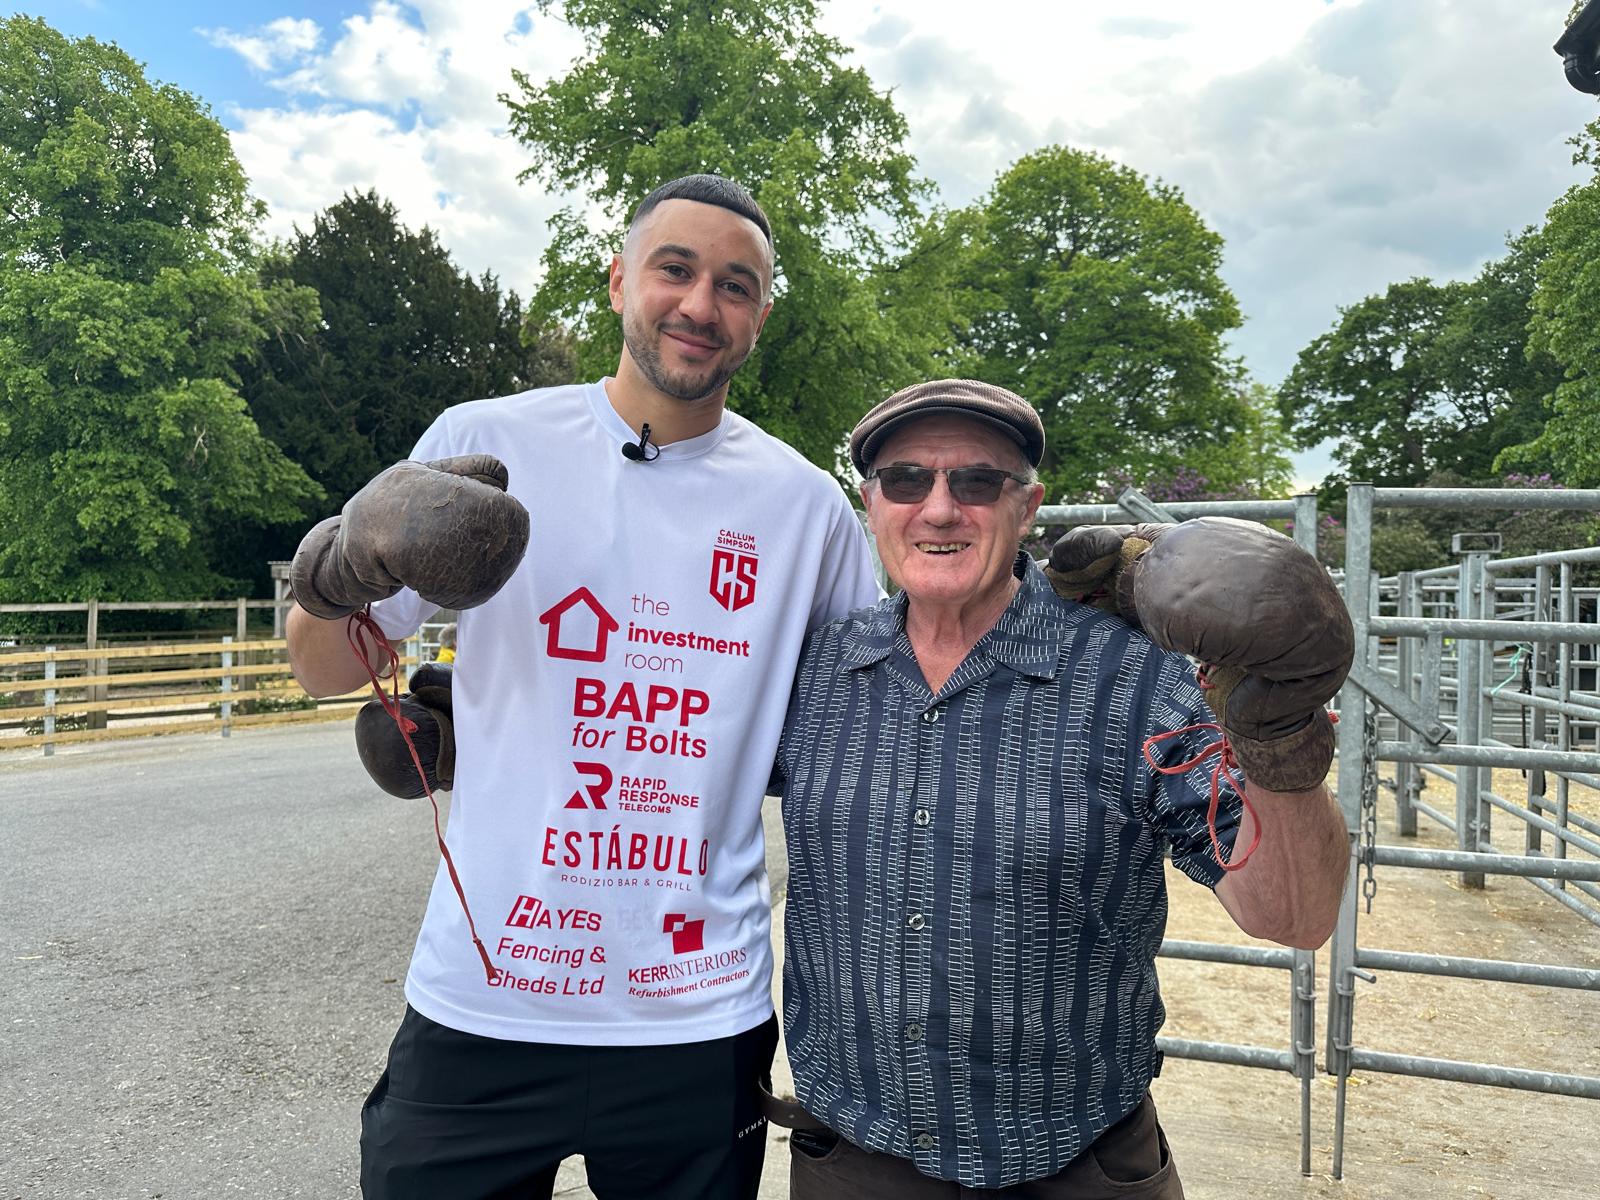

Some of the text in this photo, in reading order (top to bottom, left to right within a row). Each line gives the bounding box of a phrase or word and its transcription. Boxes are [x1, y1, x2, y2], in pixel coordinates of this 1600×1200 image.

[717, 537, 756, 551] SIMPSON
[718, 528, 756, 542] CALLUM
[631, 593, 670, 616] the
[627, 621, 750, 657] investment
[624, 653, 684, 674] room
[573, 677, 710, 727] BAPP
[571, 721, 707, 759] for Bolts
[620, 776, 667, 791] RAPID
[618, 790, 700, 808] RESPONSE
[618, 803, 672, 814] TELECOMS
[541, 824, 709, 876] ESTÁBULO
[561, 874, 692, 892] RODIZIO BAR & GRILL
[505, 895, 602, 932] HAYES
[496, 936, 606, 969] Fencing &
[487, 968, 605, 996] Sheds Ltd
[628, 967, 751, 998] Refurbishment Contractors
